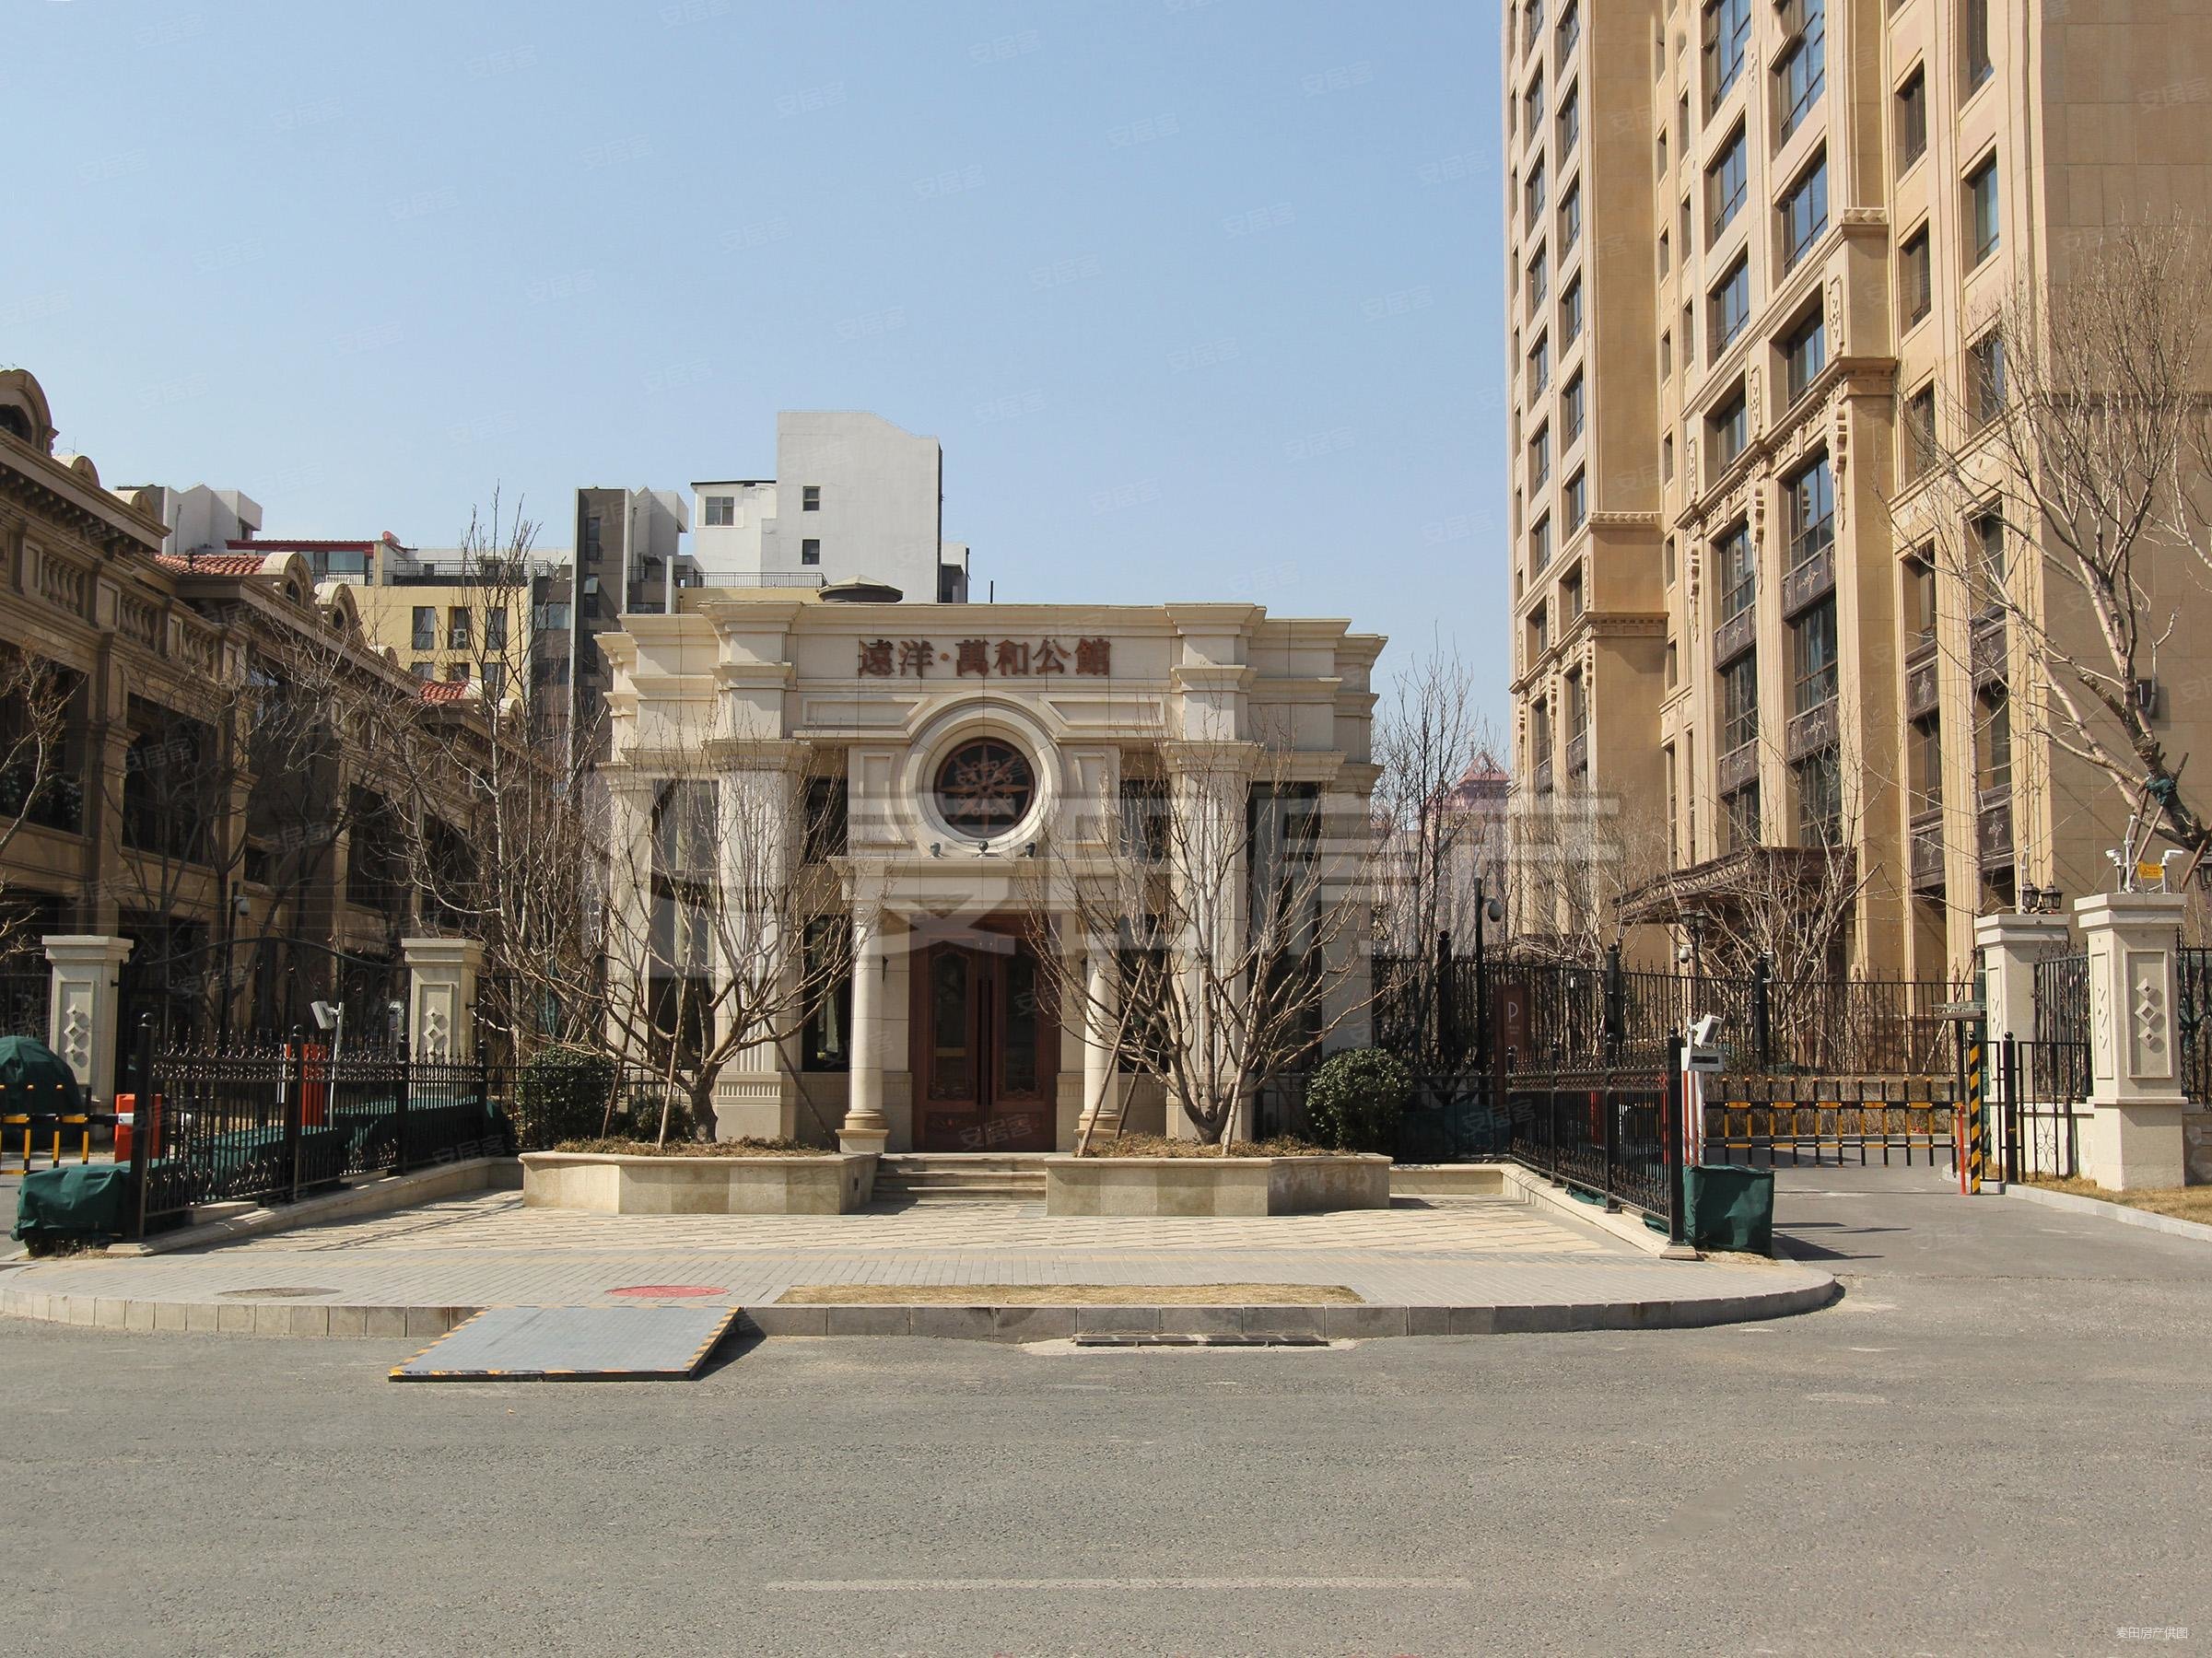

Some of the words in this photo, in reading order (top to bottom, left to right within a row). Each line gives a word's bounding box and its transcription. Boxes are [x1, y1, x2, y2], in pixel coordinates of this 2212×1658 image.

[858, 638, 1111, 679] 遠洋·萬和公館
[1508, 1001, 1518, 1022] P
